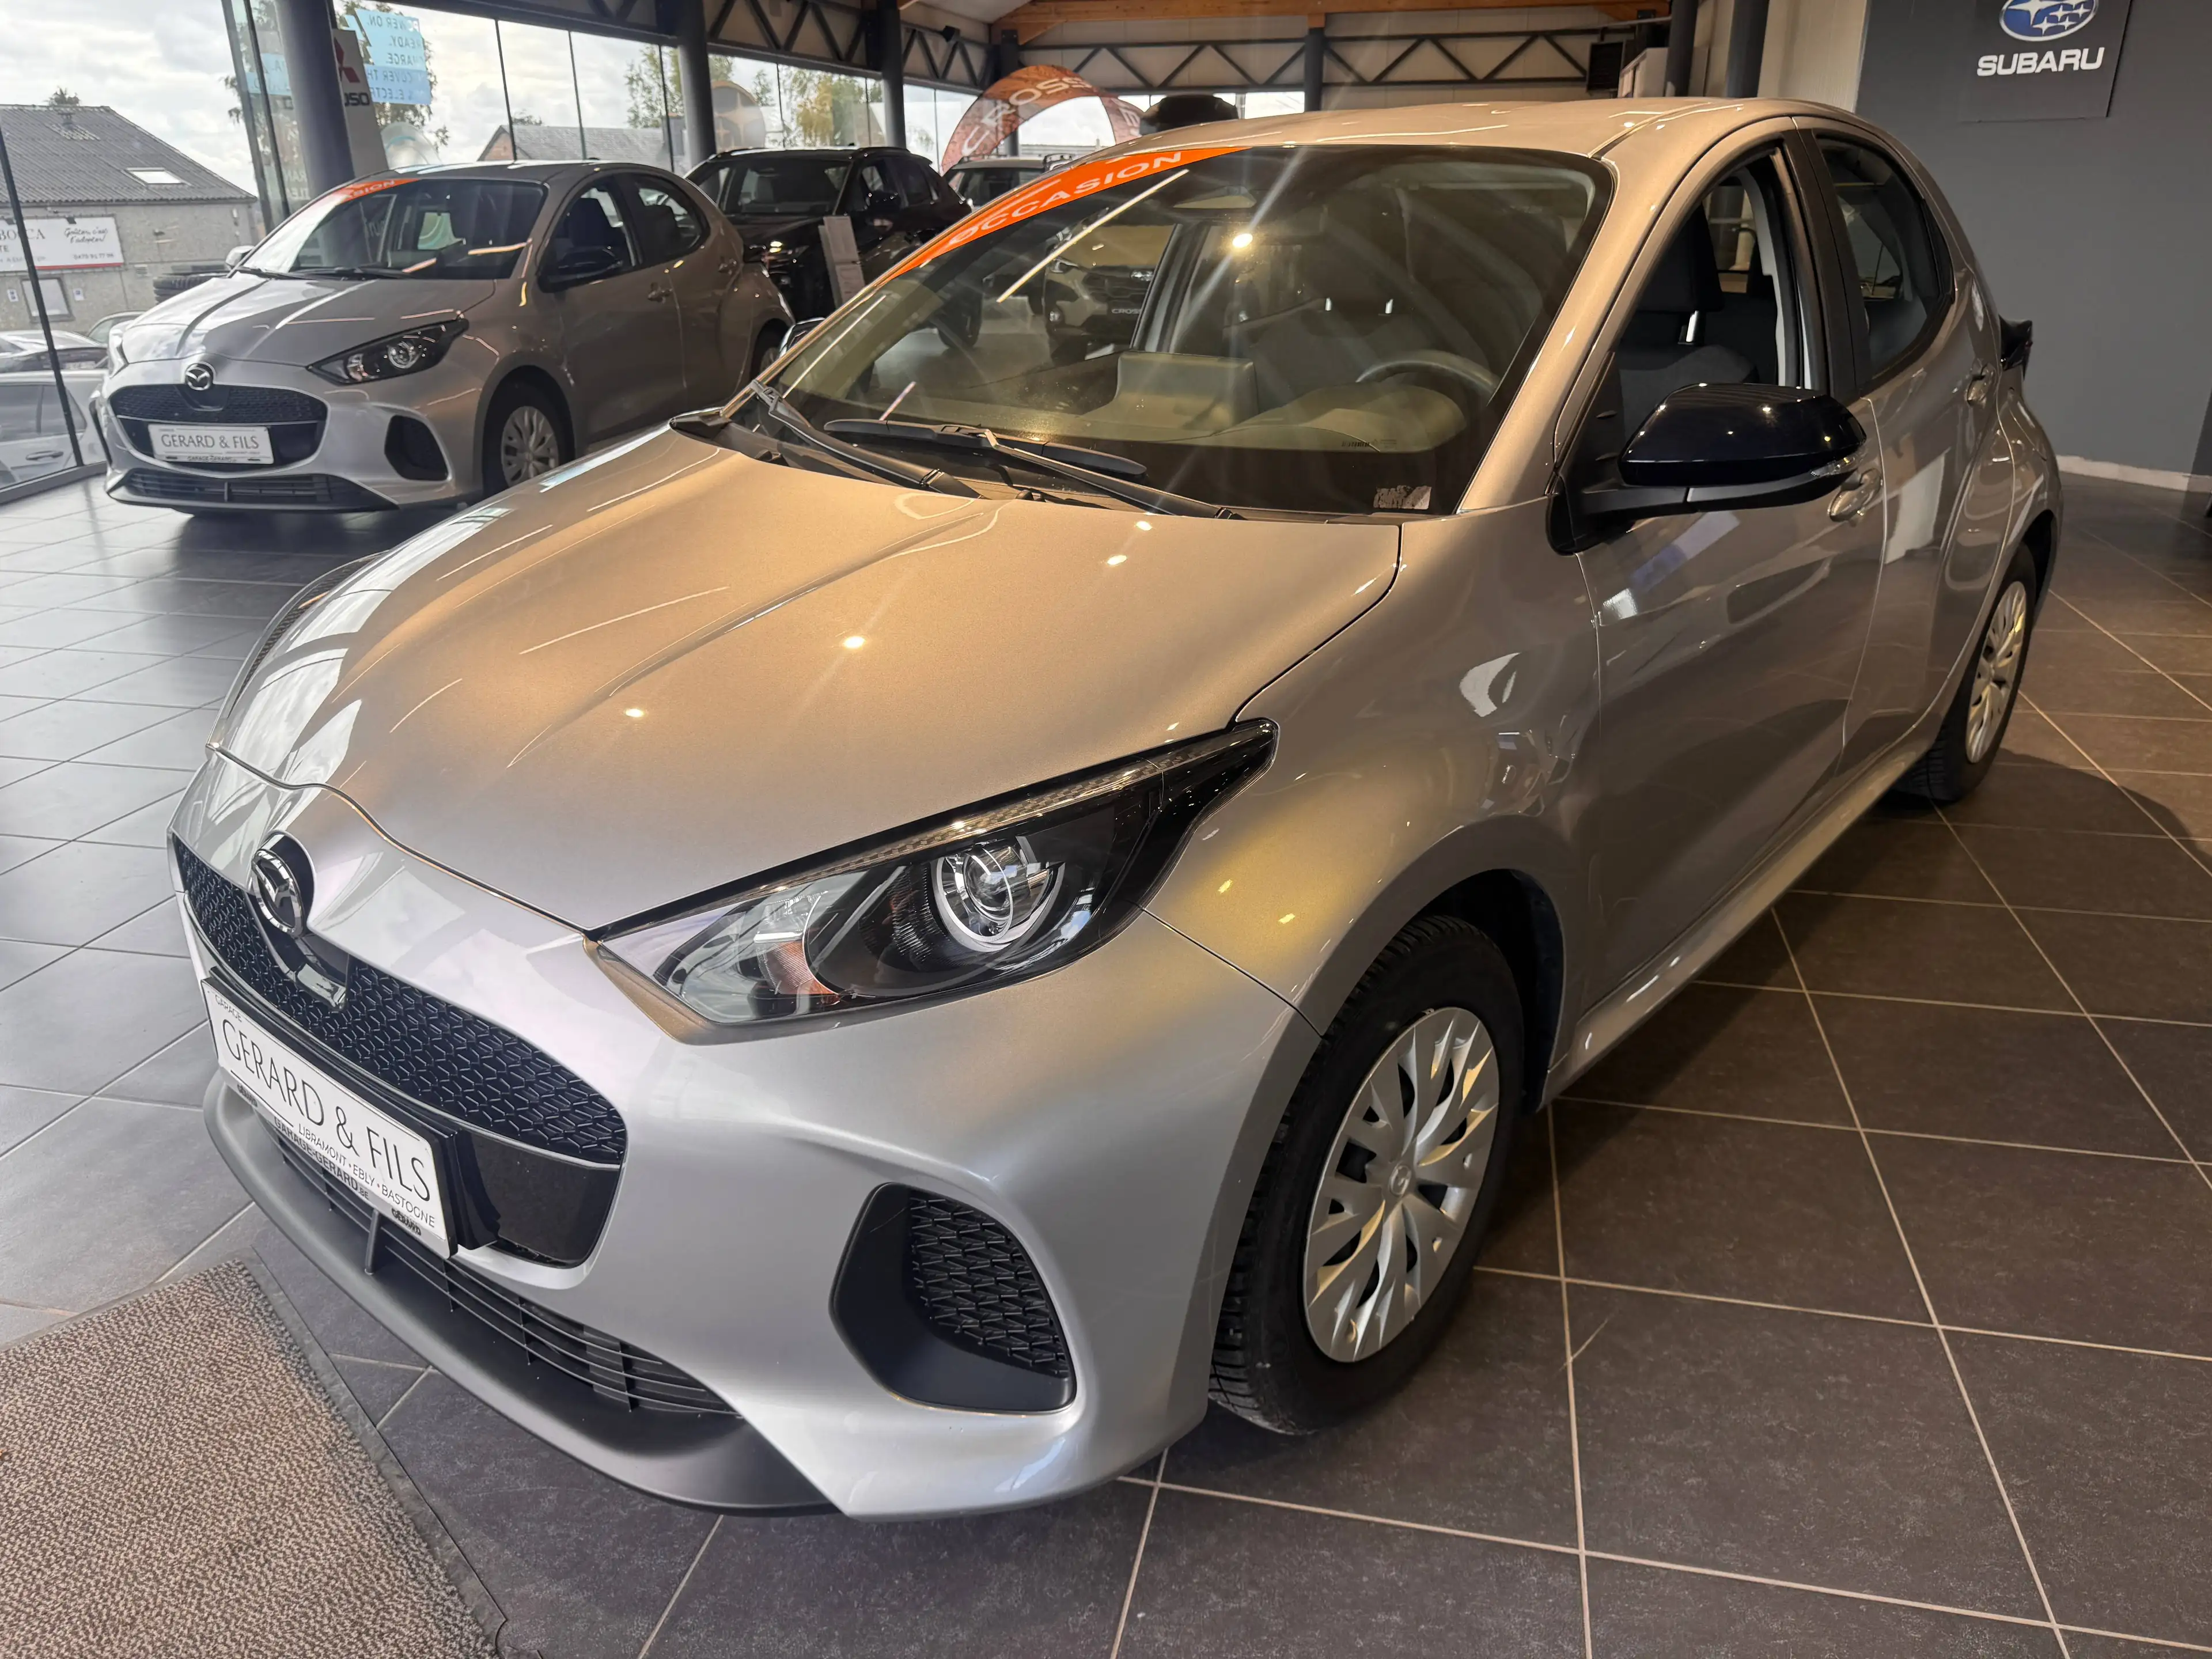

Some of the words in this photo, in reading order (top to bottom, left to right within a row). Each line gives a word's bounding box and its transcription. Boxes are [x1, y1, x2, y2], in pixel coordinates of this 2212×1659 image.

[1977, 47, 2105, 77] SUBARU
[948, 151, 1181, 245] OCCASION
[161, 434, 215, 448] GERARD
[219, 435, 230, 449] &
[233, 435, 259, 449] FILS
[215, 994, 243, 1022] GARAGE
[222, 1019, 324, 1126] GERARD
[336, 1106, 360, 1157] &
[366, 1126, 430, 1202] FILS
[298, 1123, 347, 1166] LIBRAMONT
[353, 1164, 375, 1187] EBLY
[382, 1184, 435, 1228] BASTOGNE
